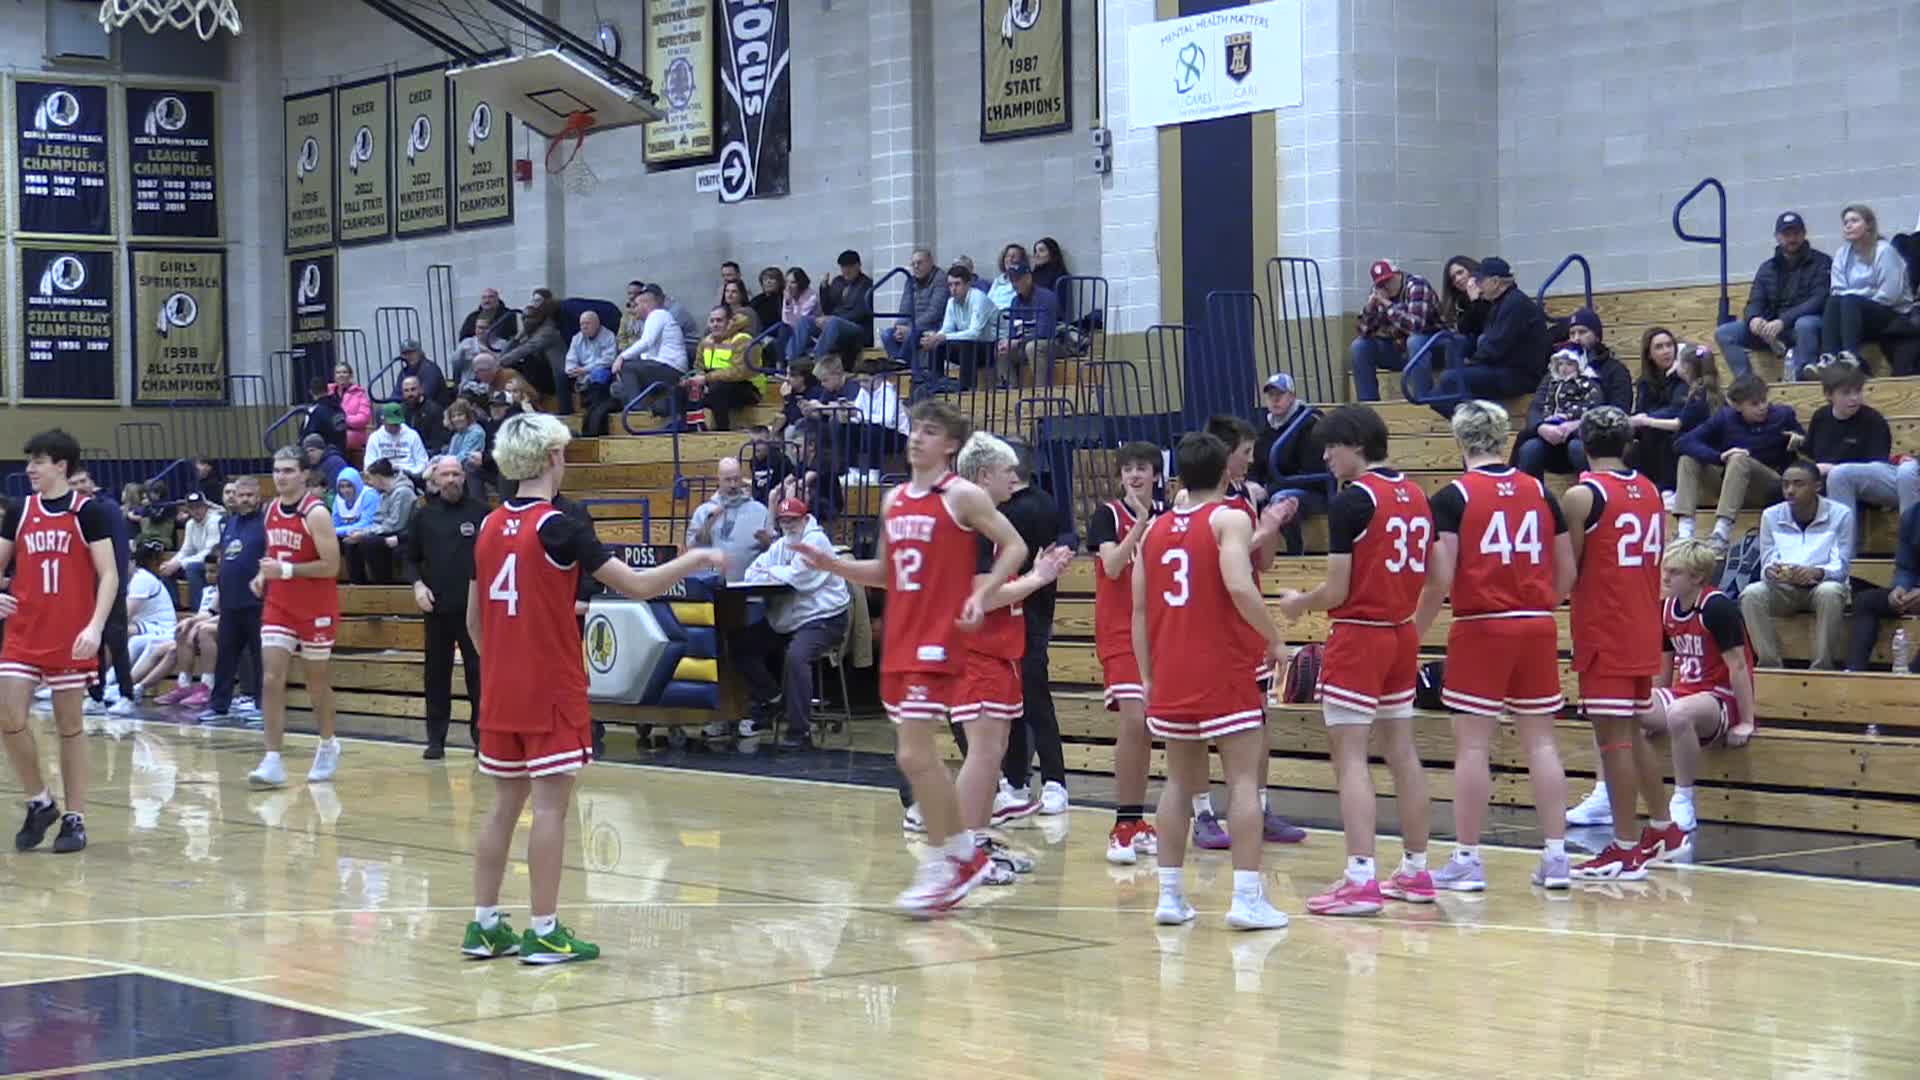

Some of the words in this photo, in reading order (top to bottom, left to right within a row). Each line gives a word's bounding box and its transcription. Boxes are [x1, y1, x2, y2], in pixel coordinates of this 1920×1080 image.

[1160, 24, 1194, 46] MENTAL
[1196, 15, 1227, 29] HEALTH
[1230, 15, 1269, 28] MATTERS
[731, 0, 775, 116] OCUS
[1010, 56, 1038, 74] 1987
[1004, 77, 1041, 96] STATE
[409, 90, 432, 104] CHEER
[352, 102, 375, 115] CHEER
[987, 97, 1061, 121] CHAMPIONS
[38, 143, 90, 159] LEAGUE
[148, 149, 199, 162] LEAGUE
[23, 157, 105, 173] CHAMPIONS
[134, 162, 213, 177] CHAMPIONS
[472, 161, 492, 176] 2023
[412, 172, 431, 186] 2022
[460, 180, 484, 194] WINTER
[486, 177, 505, 190] STATE
[362, 197, 383, 211] STATE
[400, 190, 425, 205] WINTER
[425, 187, 444, 201] STATE
[460, 195, 505, 213] CHAMPIONS
[400, 204, 445, 222] CHAMPIONS
[342, 213, 385, 231] CHAMPIONS
[160, 261, 197, 273] GIRLS
[139, 275, 181, 288] SPRING
[183, 276, 219, 289] TRACK
[28, 310, 66, 322] STATE
[70, 311, 110, 323] RELAY
[28, 323, 111, 338] CHAMPIONS
[164, 347, 198, 358] 1998
[146, 362, 216, 375] ALL-STATE
[141, 379, 221, 393] CHAMPIONS
[266, 528, 302, 550] NORTH
[1384, 516, 1431, 573] 33
[1479, 510, 1542, 565] 44
[1614, 512, 1660, 567] 24
[41, 558, 59, 594] 11
[892, 548, 922, 592] 12
[1161, 548, 1189, 607] 3
[489, 553, 518, 616] 4
